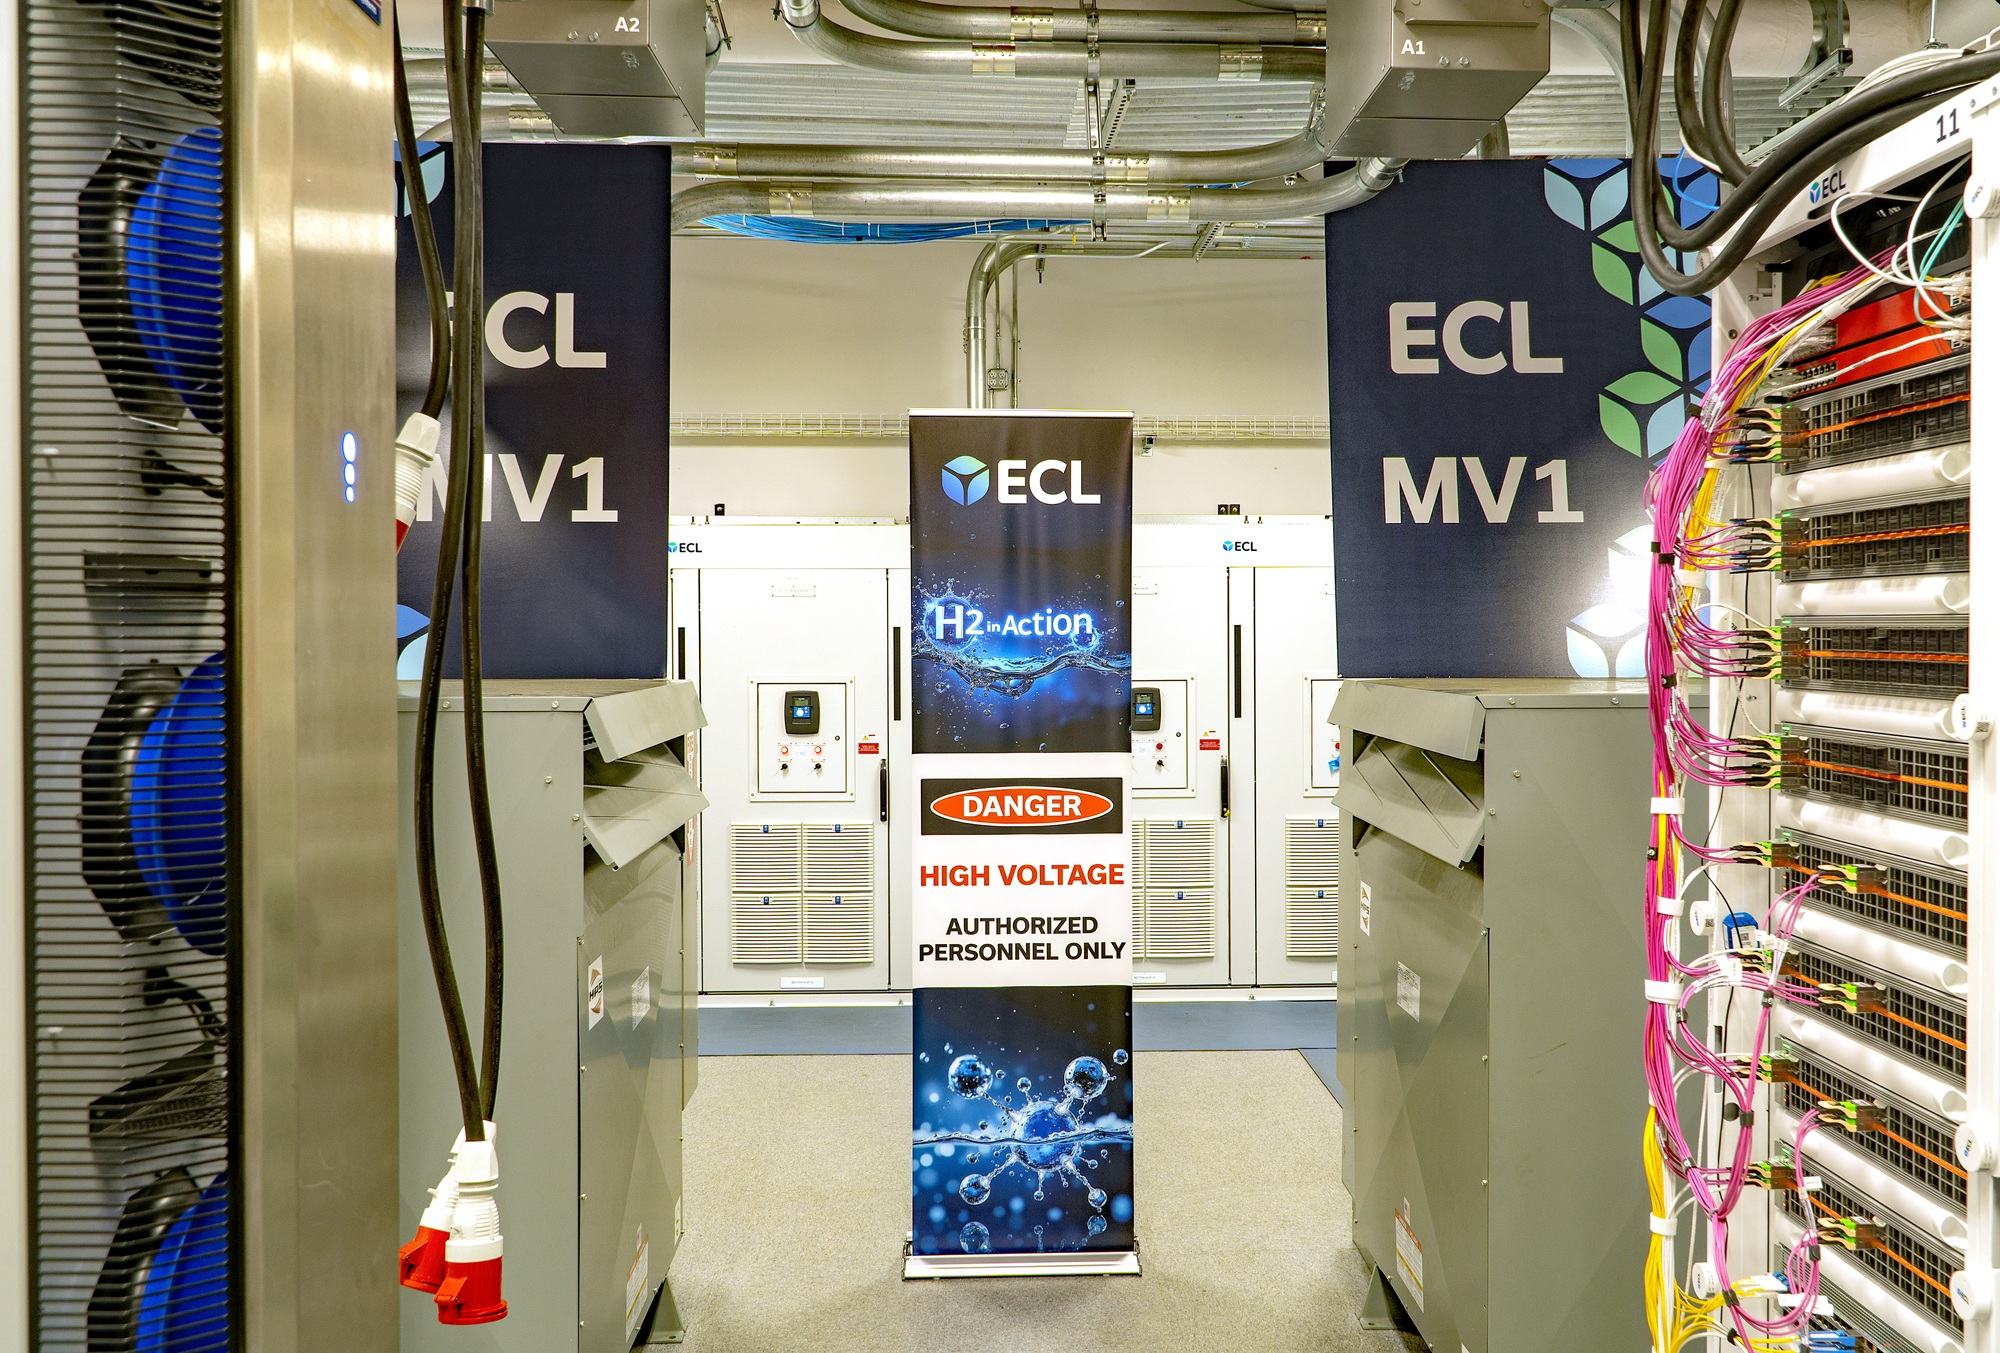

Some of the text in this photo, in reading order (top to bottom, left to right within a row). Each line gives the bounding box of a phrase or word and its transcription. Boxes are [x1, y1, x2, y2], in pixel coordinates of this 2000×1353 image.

[615, 17, 639, 32] A2
[1401, 40, 1425, 55] A1
[1936, 108, 1960, 144] 11
[1822, 170, 1846, 199] ECL
[431, 291, 607, 369] CL
[1389, 301, 1564, 375] ECL
[998, 459, 1101, 505] ECL
[1383, 457, 1585, 524] MV1
[680, 543, 702, 553] ECL
[1235, 542, 1257, 552] ECL
[935, 605, 1093, 640] H2 in Action
[963, 794, 1082, 818] DANGER
[920, 863, 1125, 887] HIGH VOLTAGE
[946, 916, 1099, 936] AUTHORIZED
[919, 941, 1126, 962] PERSONNEL ONLY
